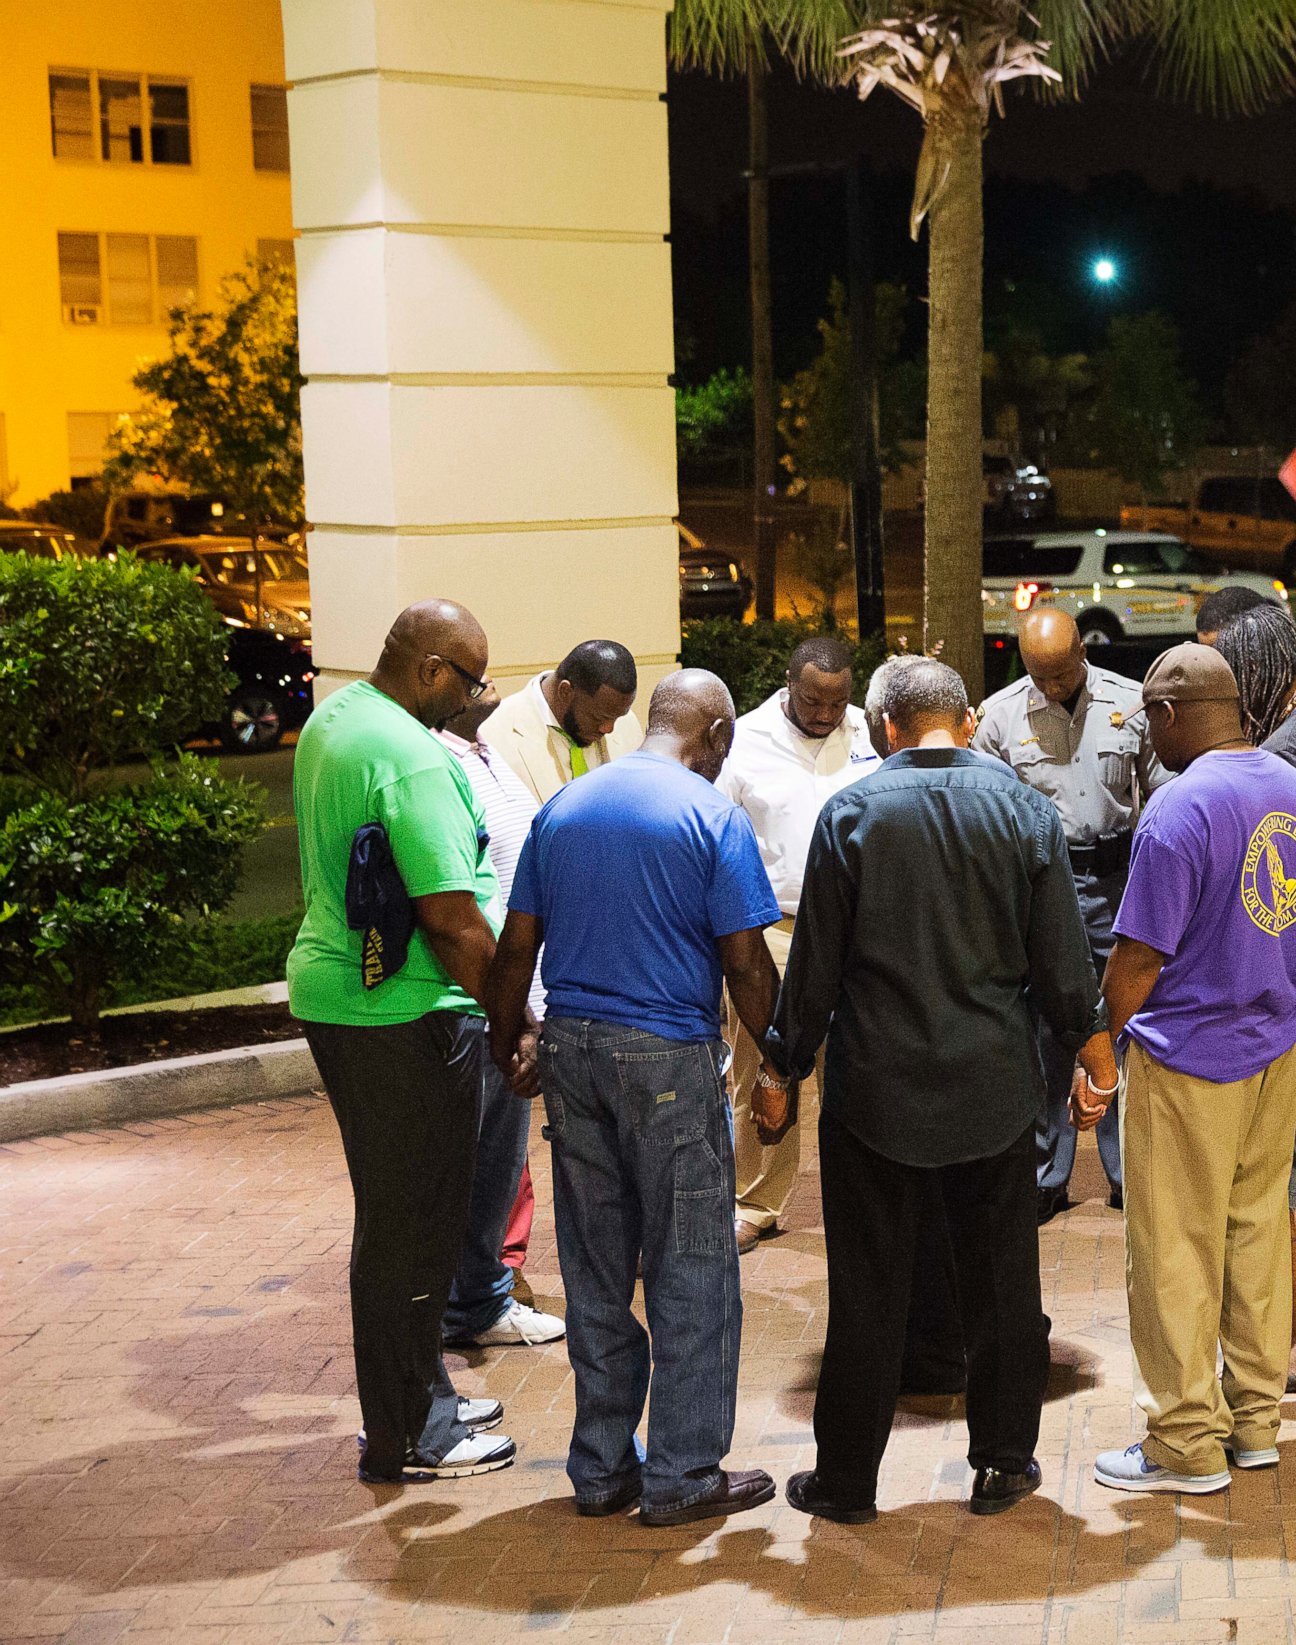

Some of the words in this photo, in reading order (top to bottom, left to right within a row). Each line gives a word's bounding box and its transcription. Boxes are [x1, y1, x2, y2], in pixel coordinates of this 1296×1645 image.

[1246, 816, 1292, 873] EMPOWERING
[1245, 887, 1259, 912] FOR
[1255, 907, 1274, 929] THE
